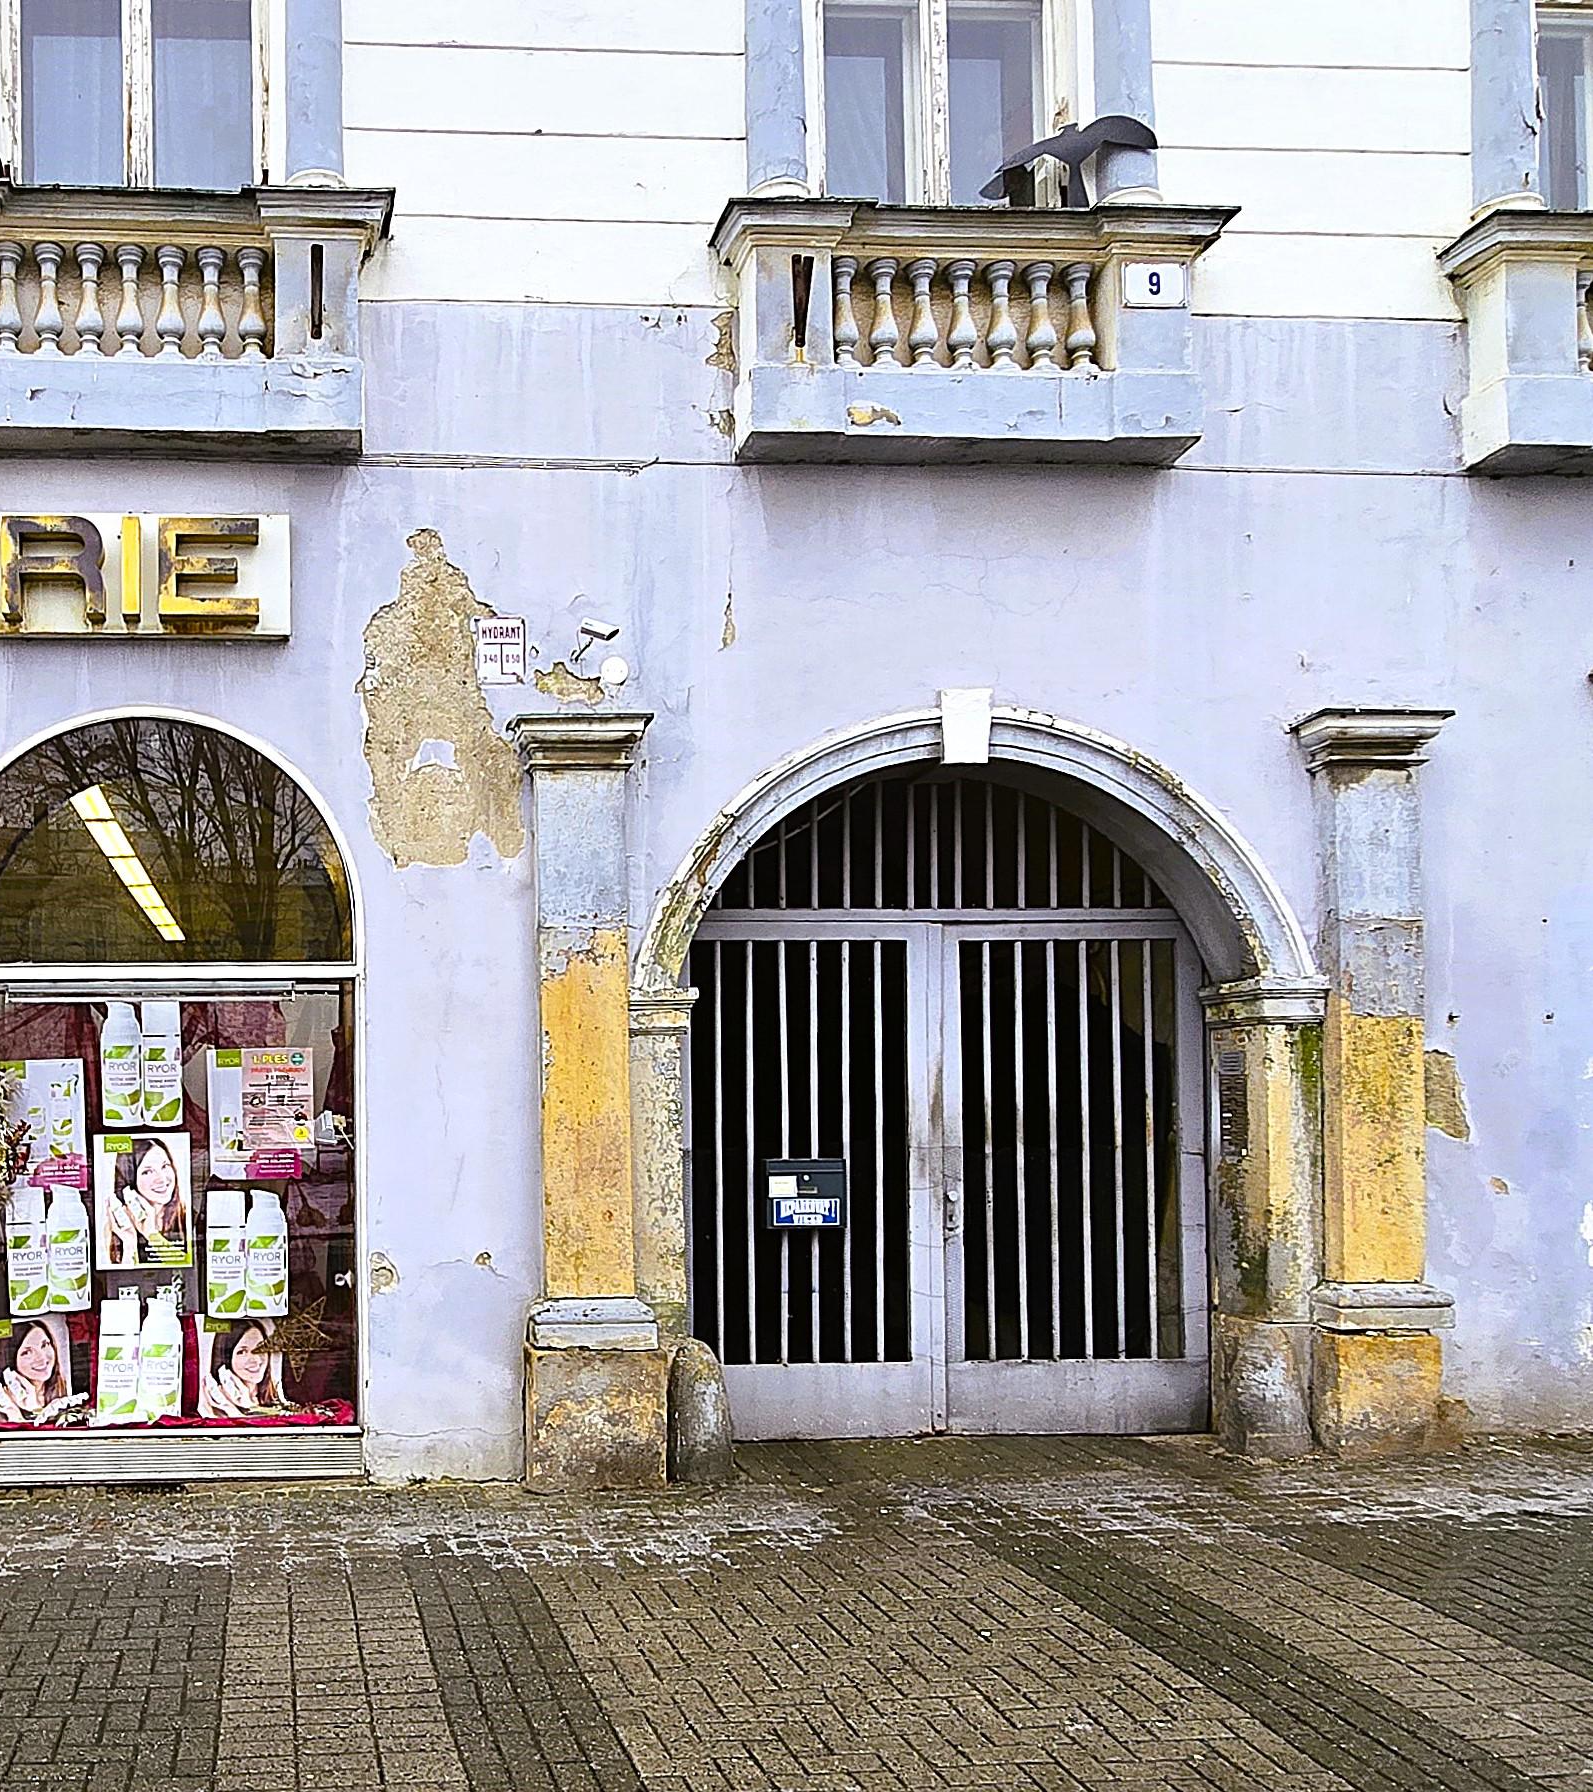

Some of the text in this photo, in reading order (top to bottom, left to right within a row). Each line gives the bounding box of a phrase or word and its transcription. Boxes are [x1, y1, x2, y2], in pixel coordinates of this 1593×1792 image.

[1148, 272, 1161, 295] 9
[481, 626, 521, 639] HYDRANT
[108, 1061, 137, 1072] RYOR
[147, 1064, 178, 1073] RYOR
[12, 1251, 43, 1261] RYOR
[55, 1246, 84, 1256] RYOR
[211, 1255, 242, 1264] RYOR
[253, 1252, 281, 1261] RYOR
[103, 1362, 134, 1373] RYOR
[146, 1360, 175, 1371] RYOR
